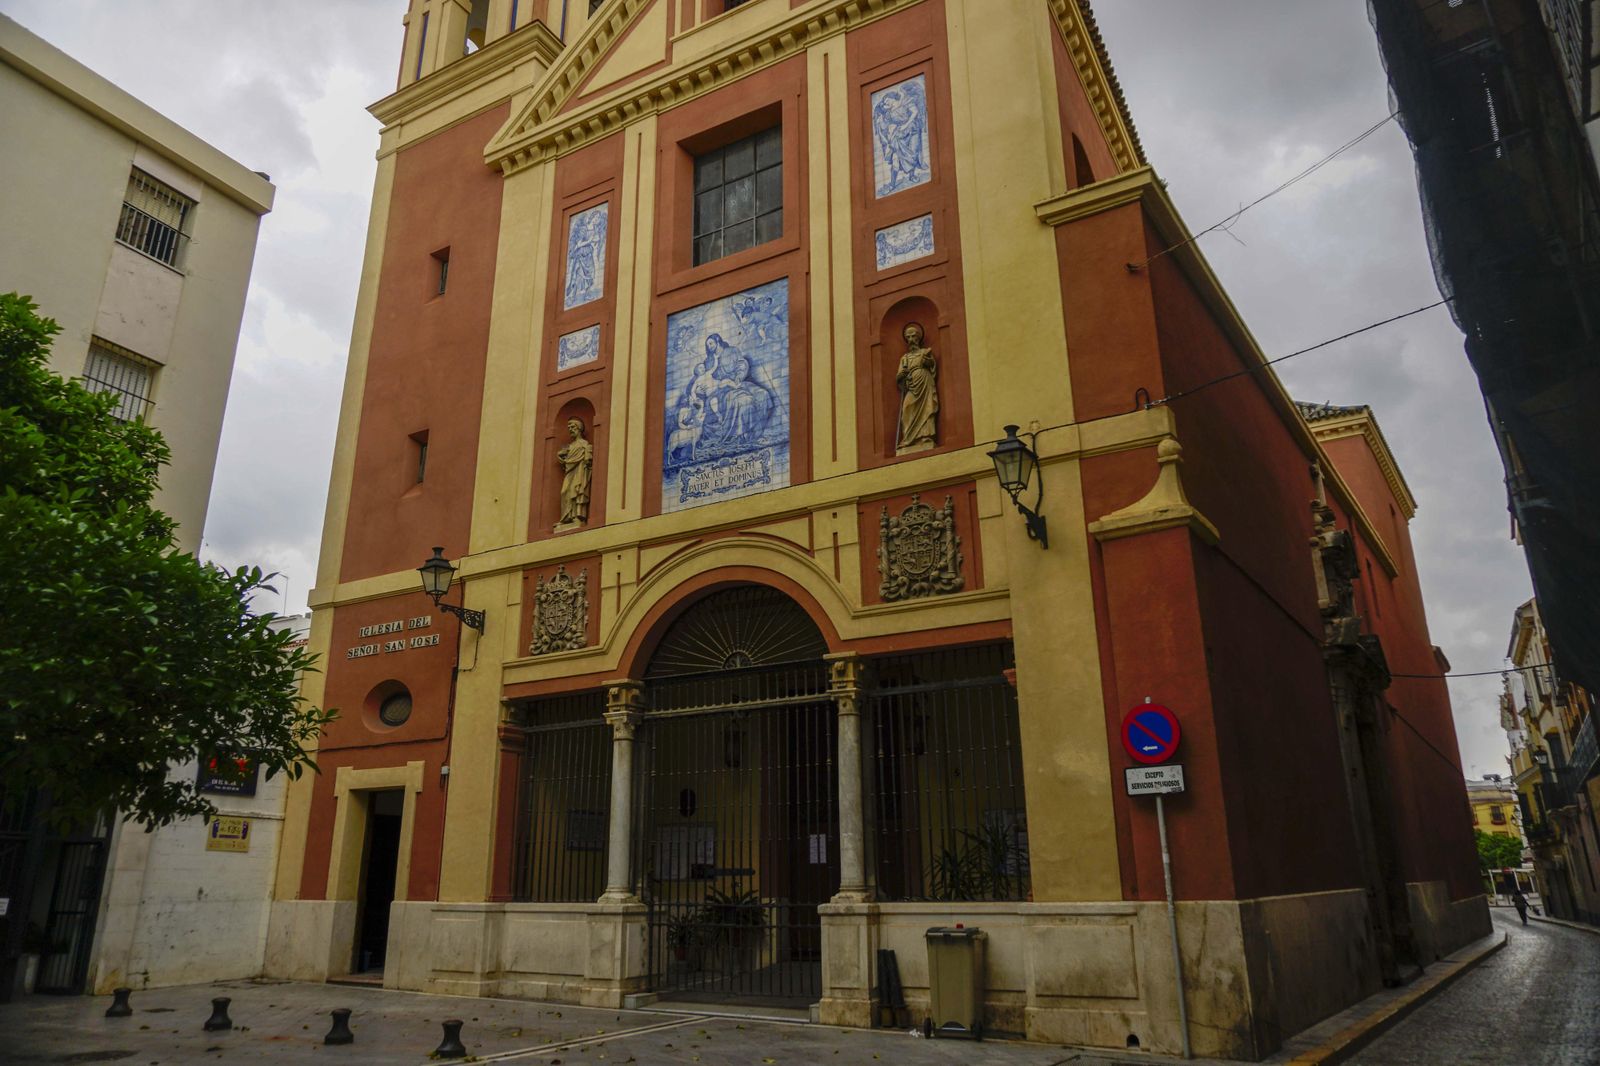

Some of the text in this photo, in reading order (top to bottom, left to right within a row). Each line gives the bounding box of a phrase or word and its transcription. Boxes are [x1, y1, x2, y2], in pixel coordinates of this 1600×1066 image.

[689, 470, 761, 492] PATER ET DOMINUS
[696, 470, 725, 481] SANCTUS
[360, 617, 429, 637] IGLESIA DEL
[347, 634, 439, 658] SEÑOR SAN JOSE
[1145, 771, 1164, 779] EXCEPTO
